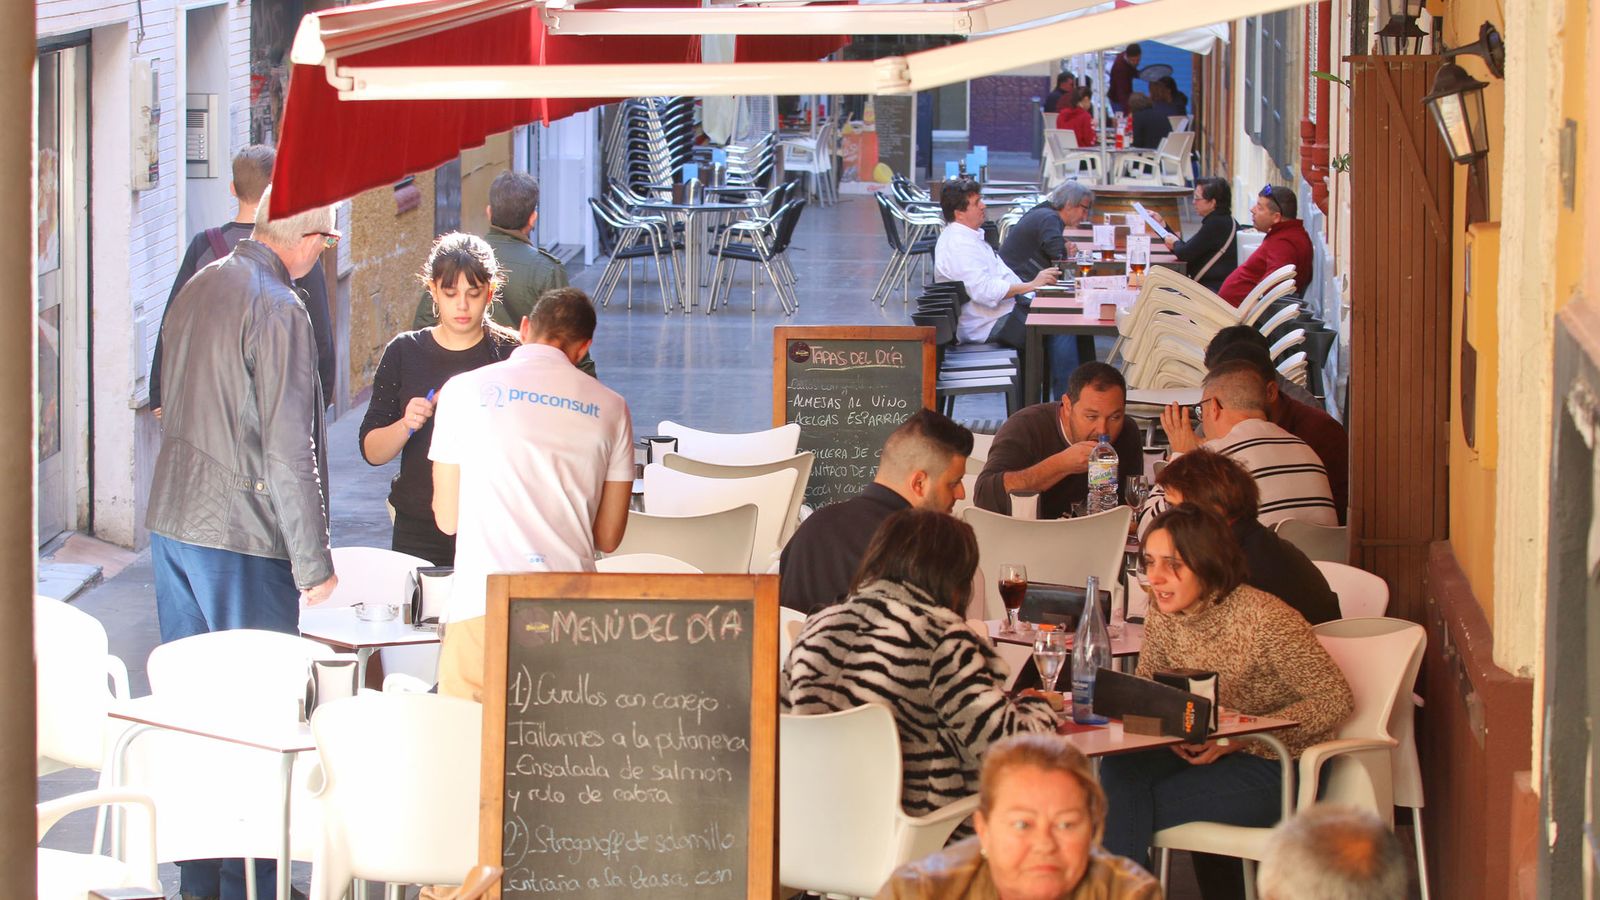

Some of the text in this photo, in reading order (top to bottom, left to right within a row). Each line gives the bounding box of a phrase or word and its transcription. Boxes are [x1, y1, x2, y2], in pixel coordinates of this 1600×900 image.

[809, 346, 903, 365] TAPAS DEL DÍA
[509, 388, 600, 418] proconsult
[848, 396, 861, 408] AL
[847, 411, 909, 427] ESPARRAG
[851, 446, 869, 459] DE
[849, 464, 867, 478] DE
[629, 612, 679, 642] DEL
[687, 605, 743, 644] DÍA
[612, 733, 627, 748] a
[632, 721, 651, 748] la
[619, 754, 643, 779] de
[507, 784, 672, 812] y rulo de cabra
[625, 831, 649, 851] de
[587, 879, 600, 890] a
[604, 867, 624, 888] la
[695, 868, 733, 885] con
